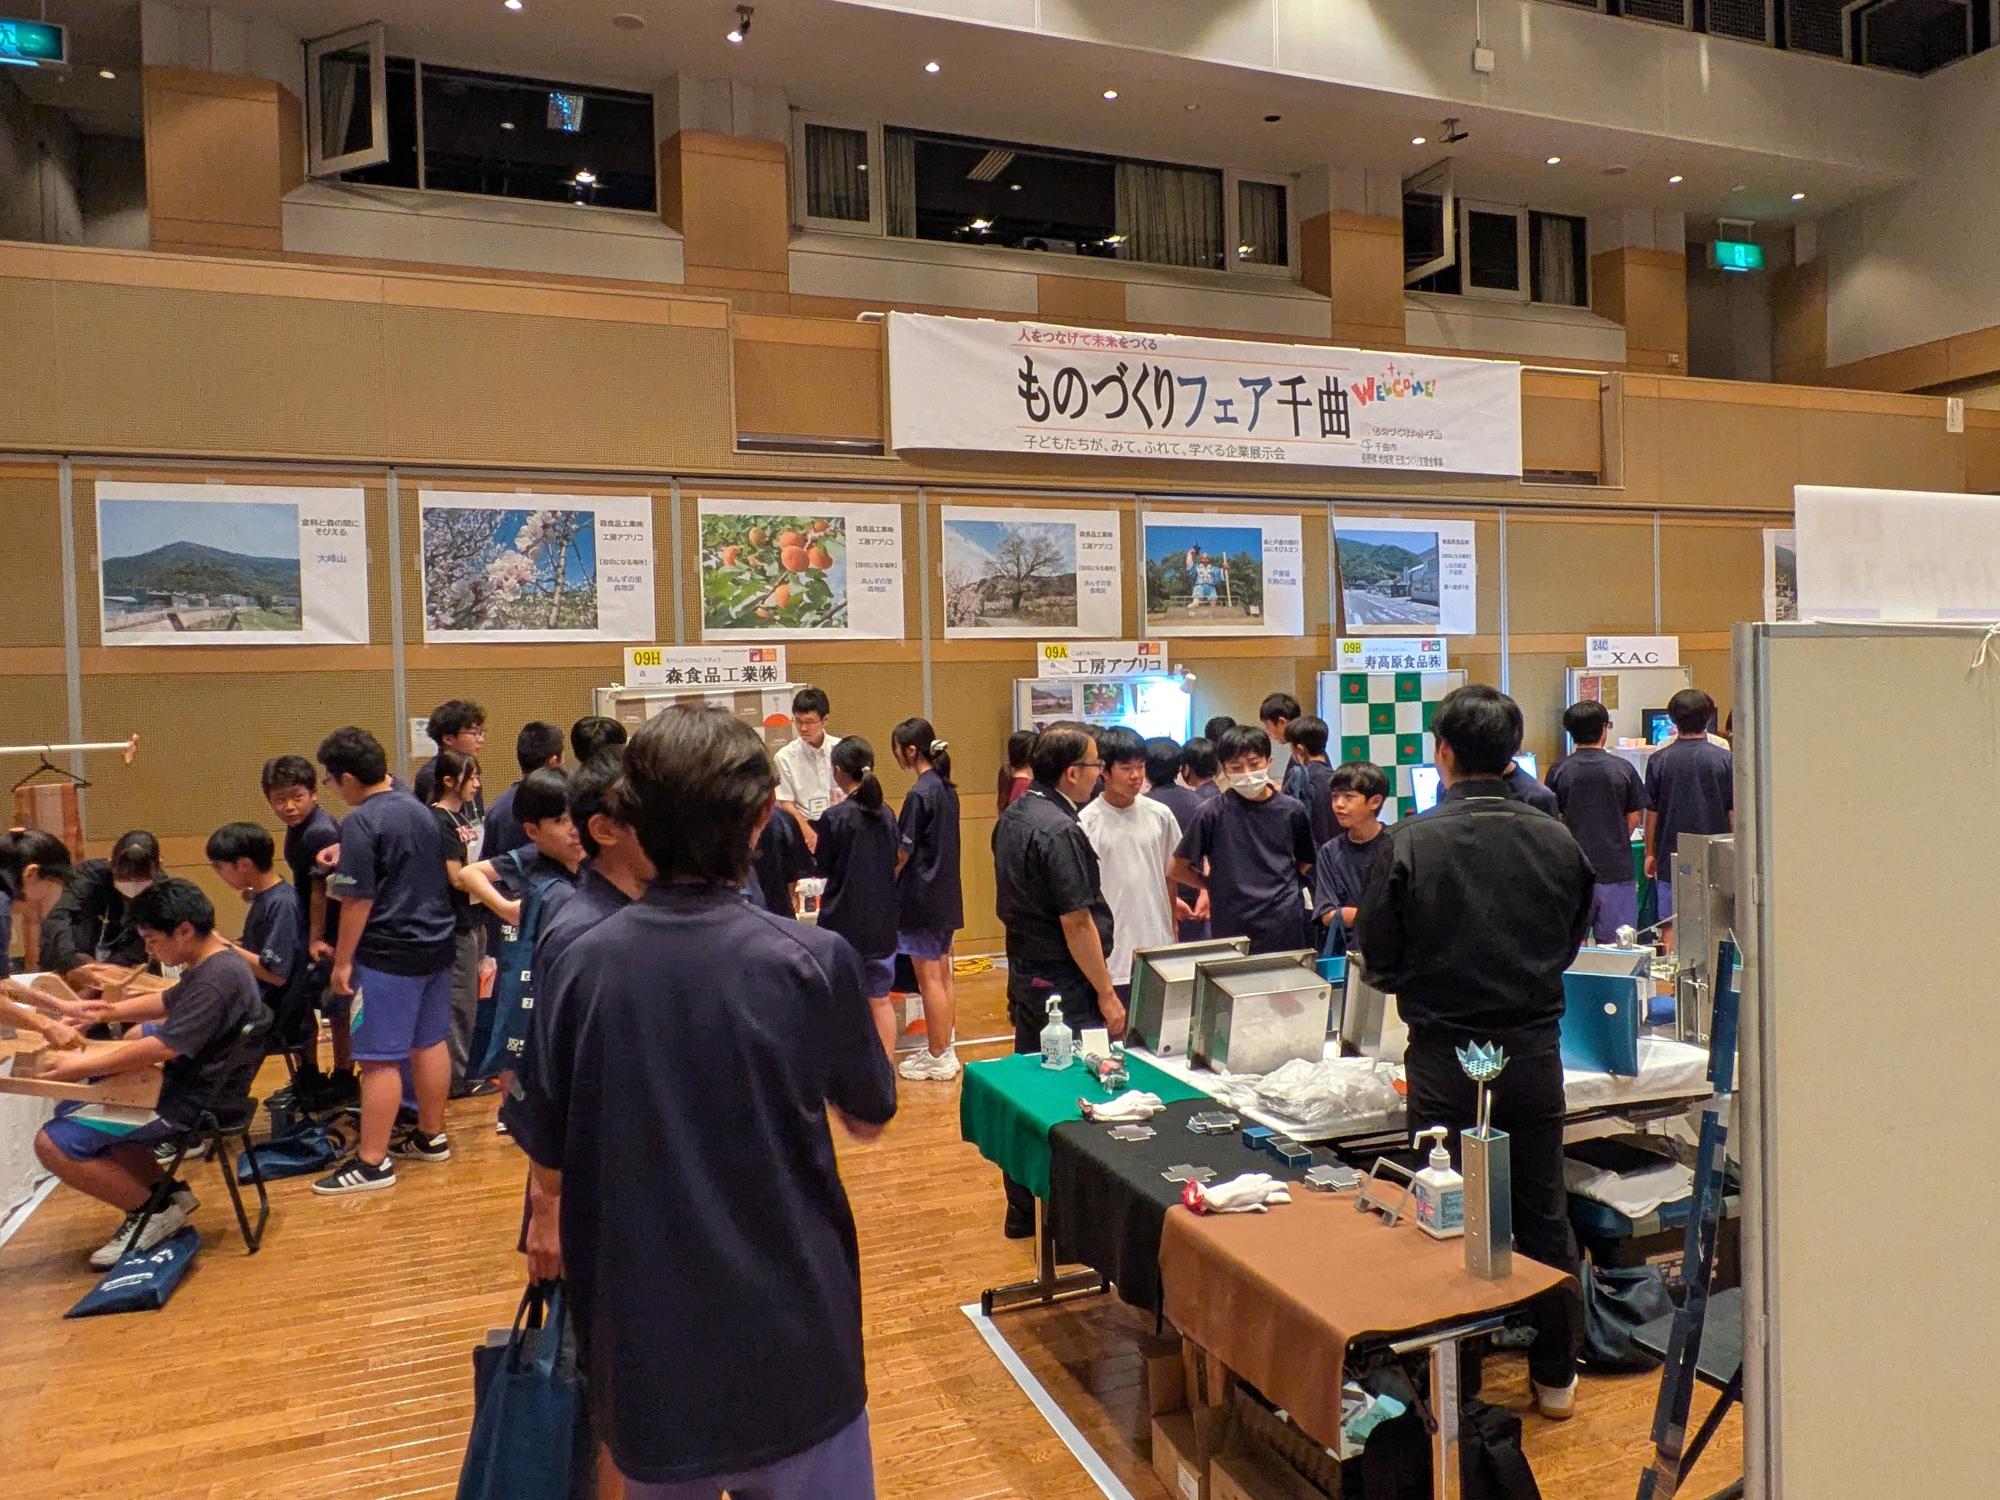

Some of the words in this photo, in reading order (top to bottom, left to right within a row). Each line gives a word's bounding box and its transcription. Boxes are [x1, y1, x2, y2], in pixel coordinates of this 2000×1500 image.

[1018, 328, 1158, 350] 人をつなげて未来をつくる
[1018, 355, 1350, 438] ものづくりフェア千曲
[1024, 434, 1286, 460] 子どもたちが、みて、ふれて、学べる企業展示会
[315, 528, 347, 536] そびえる
[1343, 642, 1362, 653] 09B
[1592, 640, 1608, 651] 24C
[634, 651, 661, 665] 09H
[1045, 646, 1068, 659] 09A
[1611, 652, 1659, 664] XAC
[1072, 658, 1161, 674] 工房アプリコ
